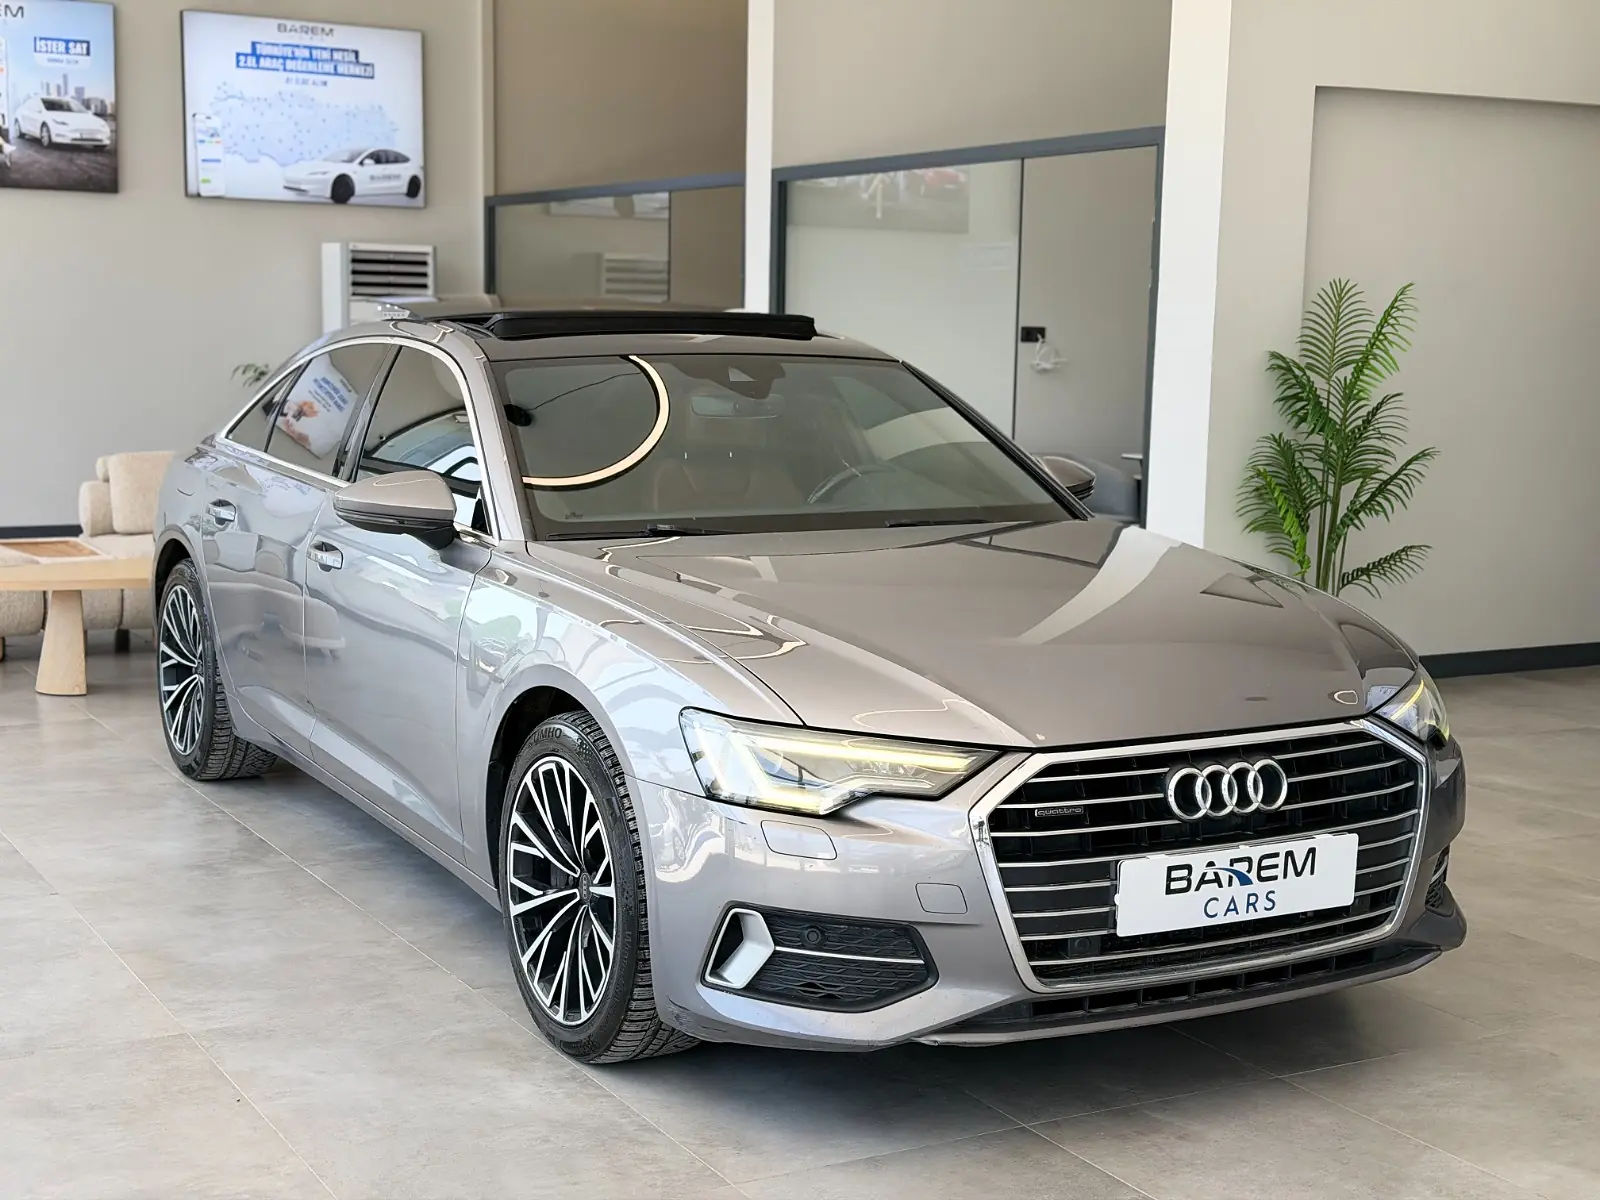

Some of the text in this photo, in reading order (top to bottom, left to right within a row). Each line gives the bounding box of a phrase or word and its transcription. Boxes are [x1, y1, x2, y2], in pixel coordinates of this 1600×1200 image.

[277, 23, 334, 37] BAREM
[36, 36, 66, 54] İSTER
[1037, 807, 1082, 816] quattro
[1165, 846, 1317, 896] BAREM
[1203, 890, 1276, 919] CARS
